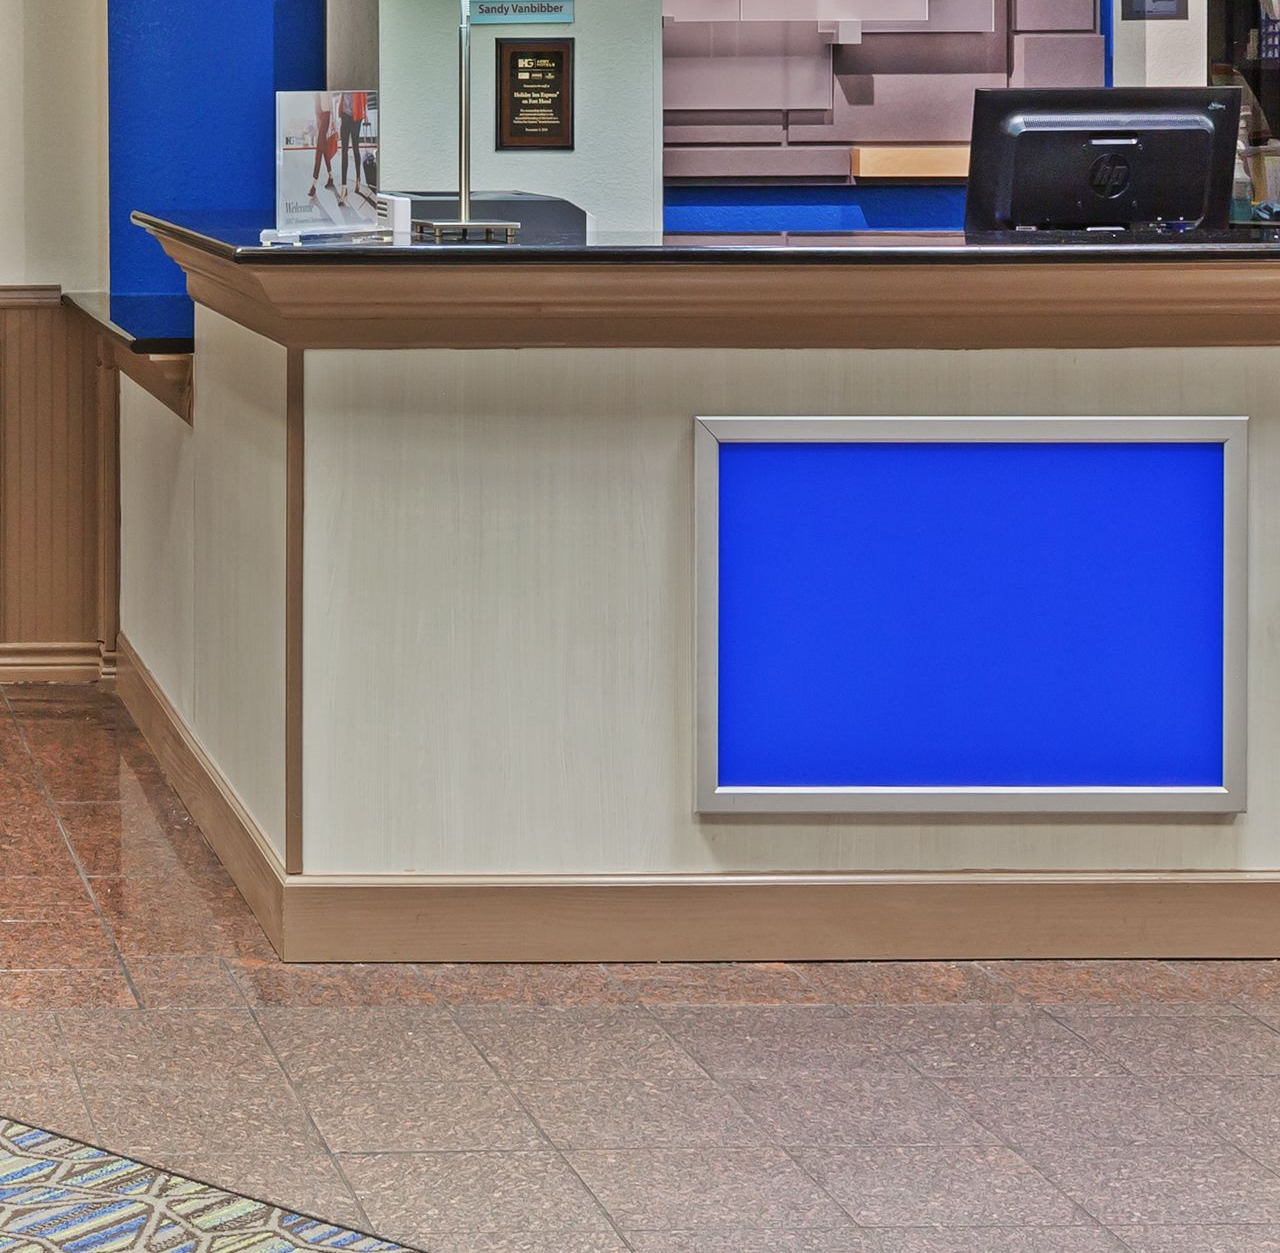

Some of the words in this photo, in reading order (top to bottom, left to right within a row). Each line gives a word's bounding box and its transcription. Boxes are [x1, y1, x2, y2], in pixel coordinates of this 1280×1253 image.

[478, 4, 509, 15] Sandy
[511, 3, 564, 13] Vanbibber
[517, 58, 534, 68] IHG
